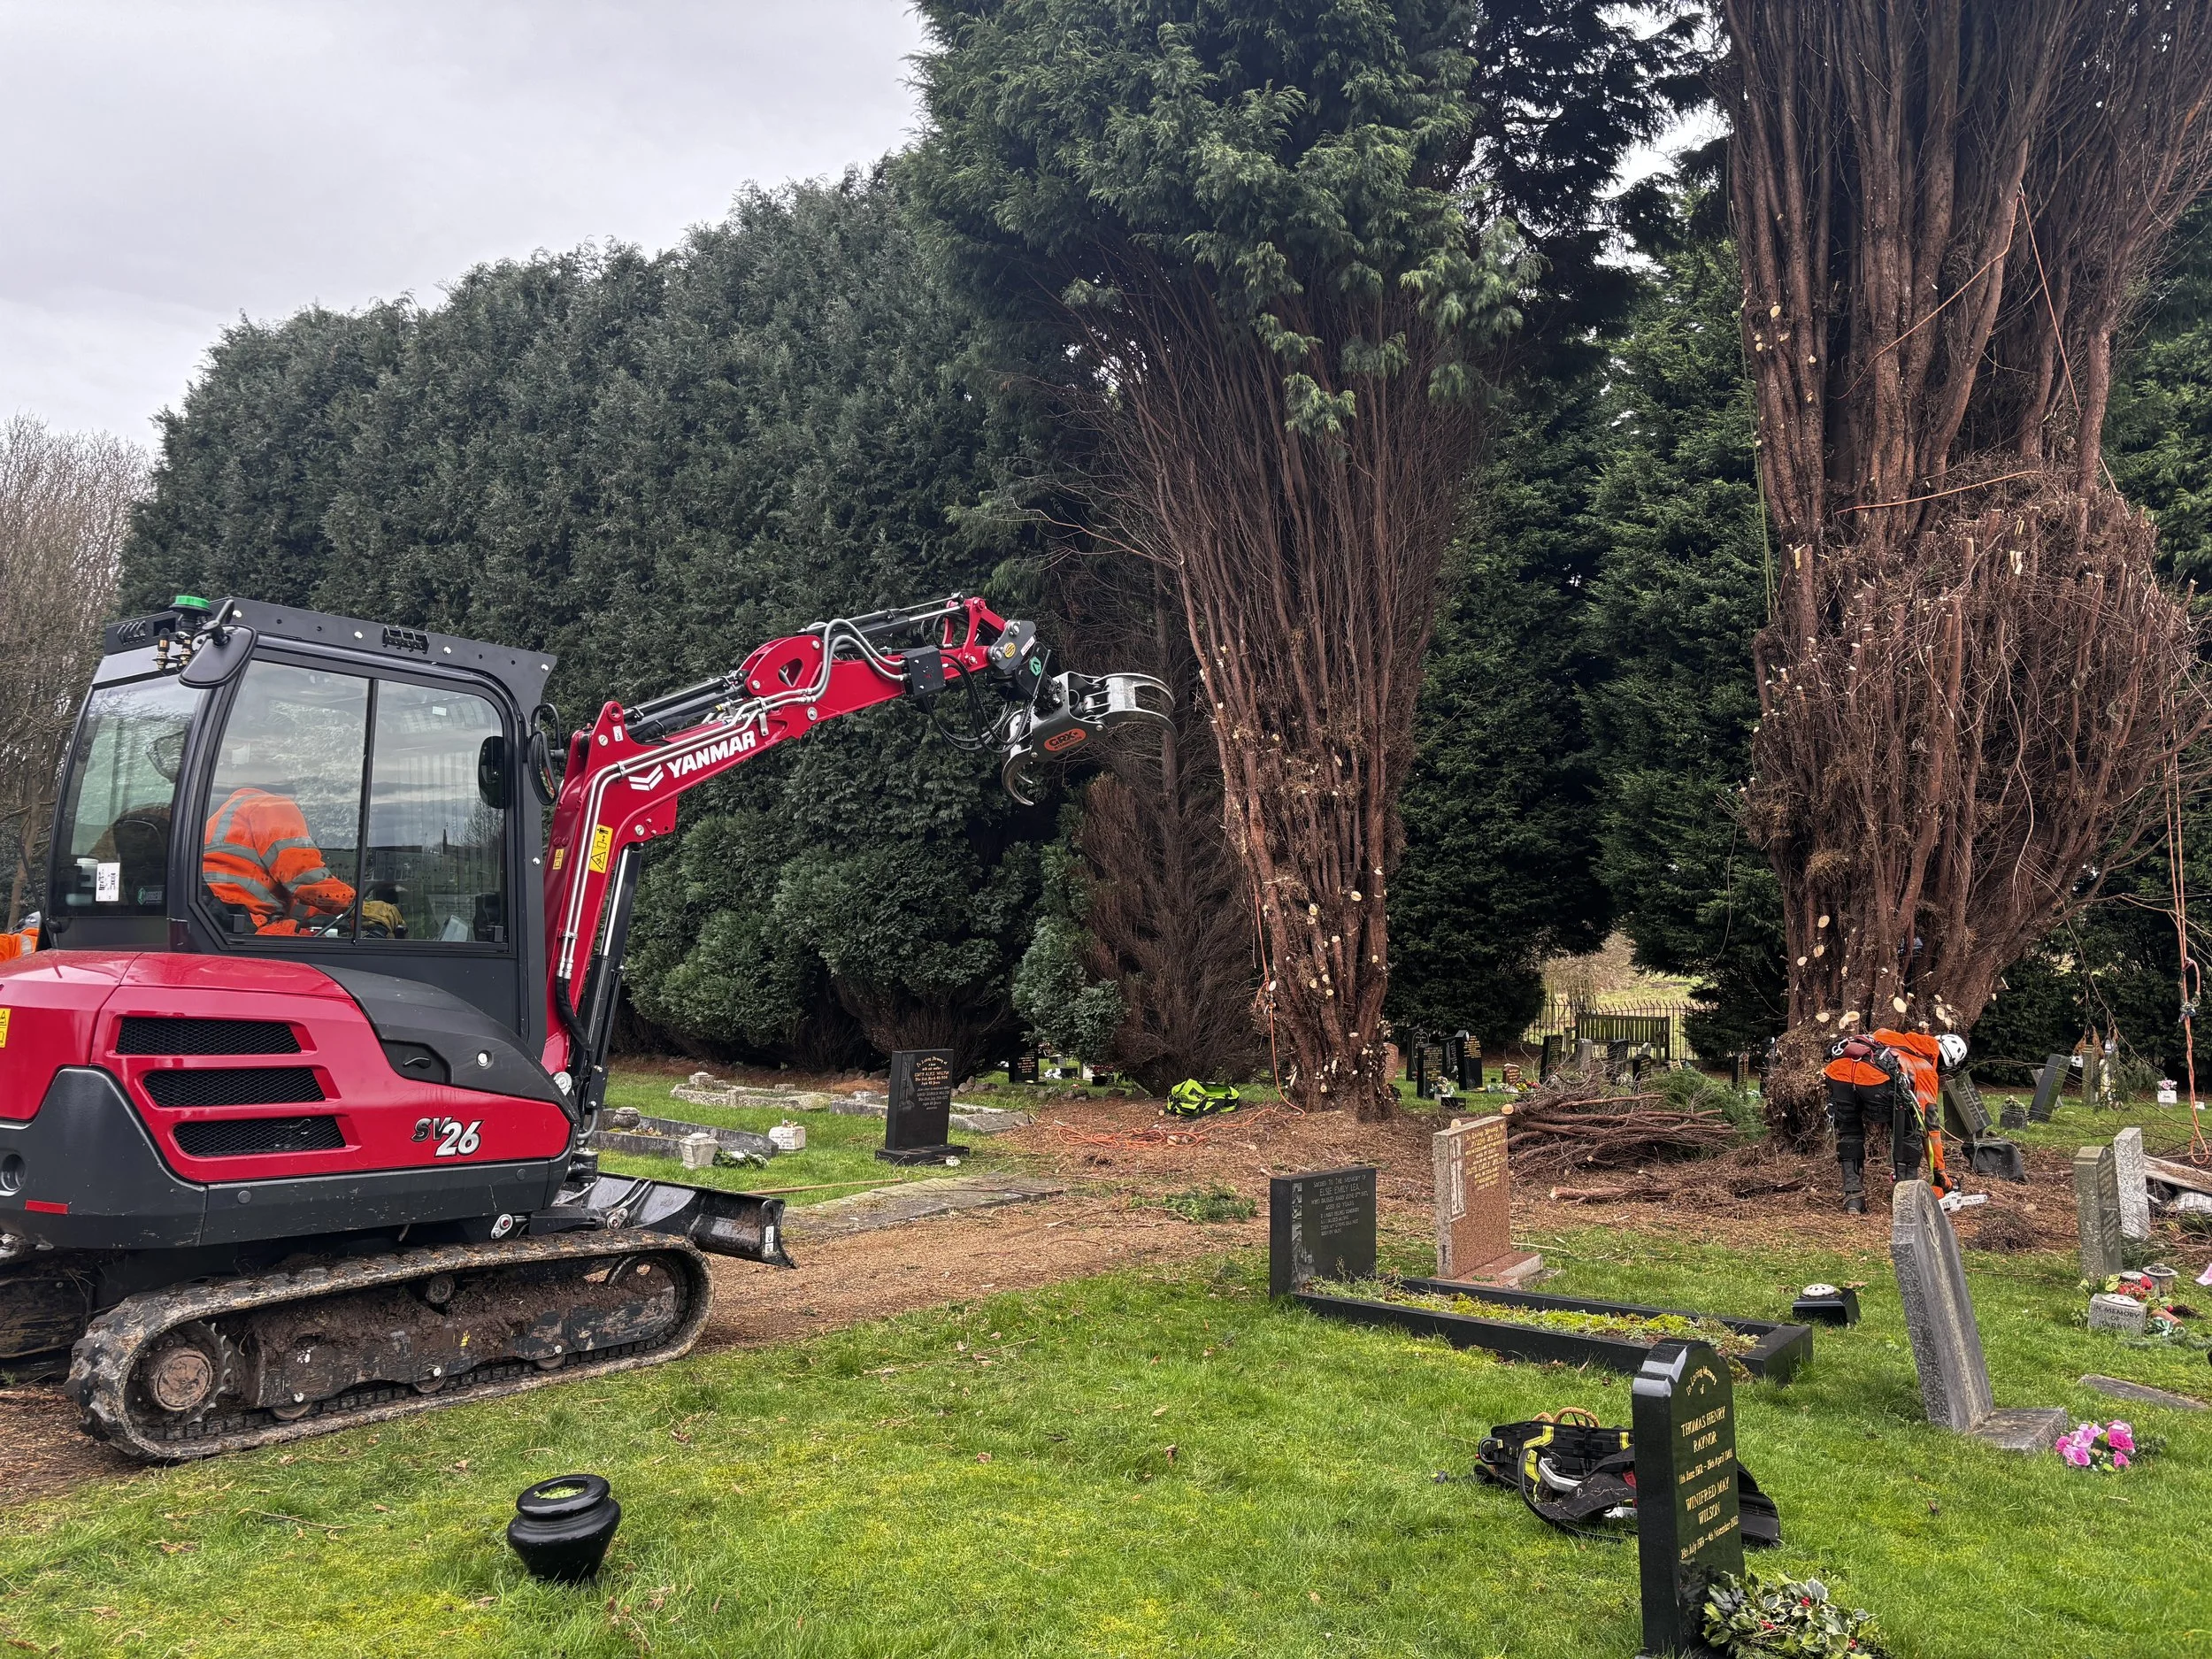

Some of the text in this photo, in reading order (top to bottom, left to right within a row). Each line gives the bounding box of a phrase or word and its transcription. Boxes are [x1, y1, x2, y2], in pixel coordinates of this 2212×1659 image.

[667, 730, 757, 779] YANMAR
[411, 1116, 484, 1158] SV26
[2104, 1307, 2140, 1318] MEMORY
[1690, 1368, 1703, 1387] Loving
[1702, 1365, 1717, 1386] Memory
[1680, 1405, 1726, 1438] THOMAS HENRY
[1693, 1431, 1717, 1453] RAYNOR
[1686, 1476, 1730, 1511] WINIFRED MAY
[1698, 1502, 1721, 1525] WILSON
